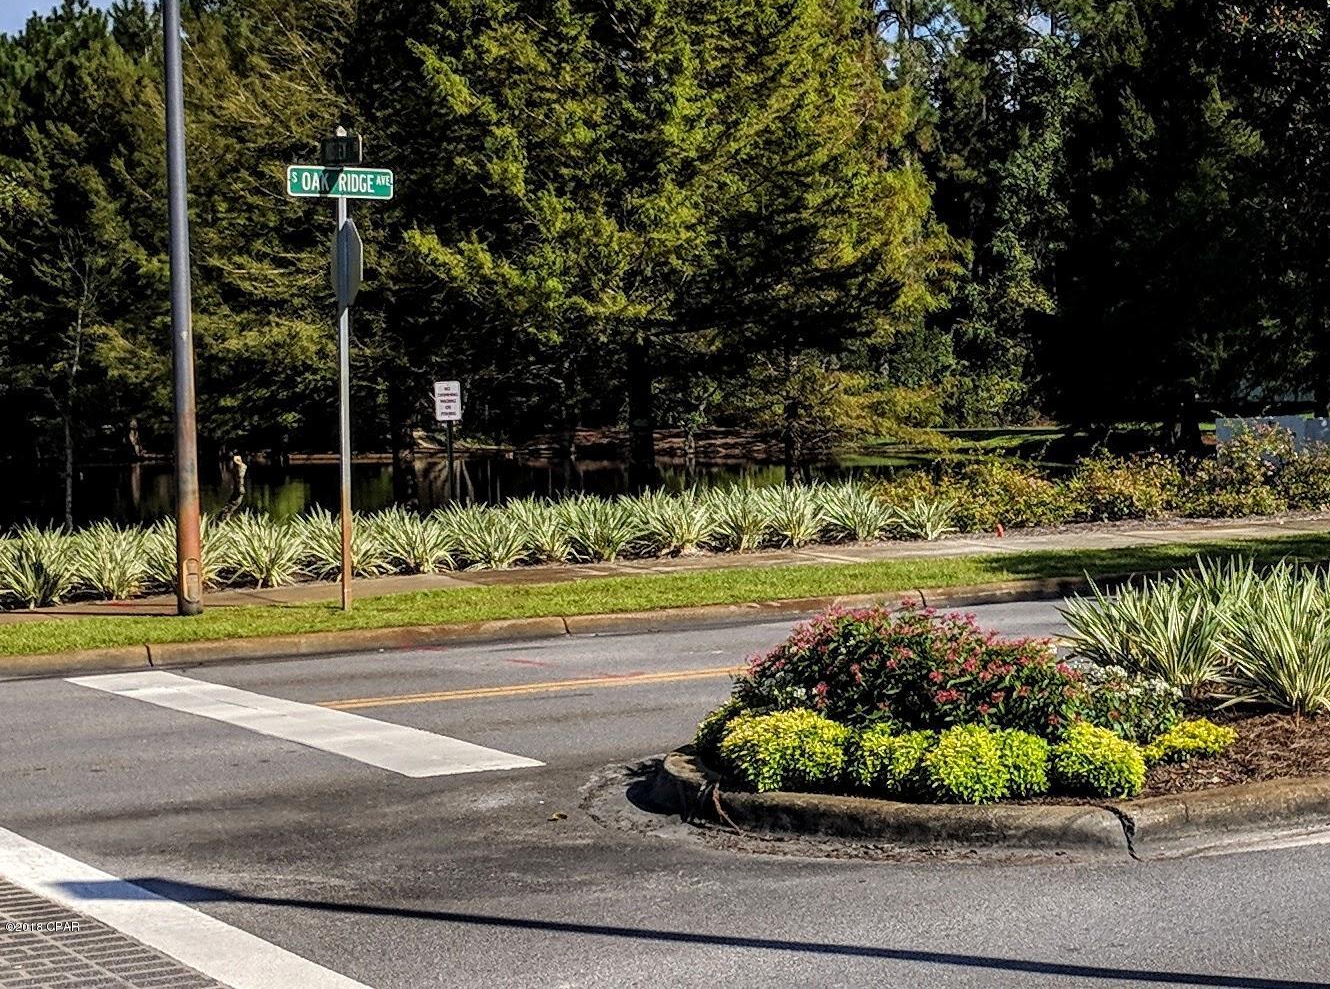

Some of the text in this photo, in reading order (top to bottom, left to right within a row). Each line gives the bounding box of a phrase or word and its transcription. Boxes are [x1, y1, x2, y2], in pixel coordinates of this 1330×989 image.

[291, 171, 391, 193] S OAK RIDGE AVE
